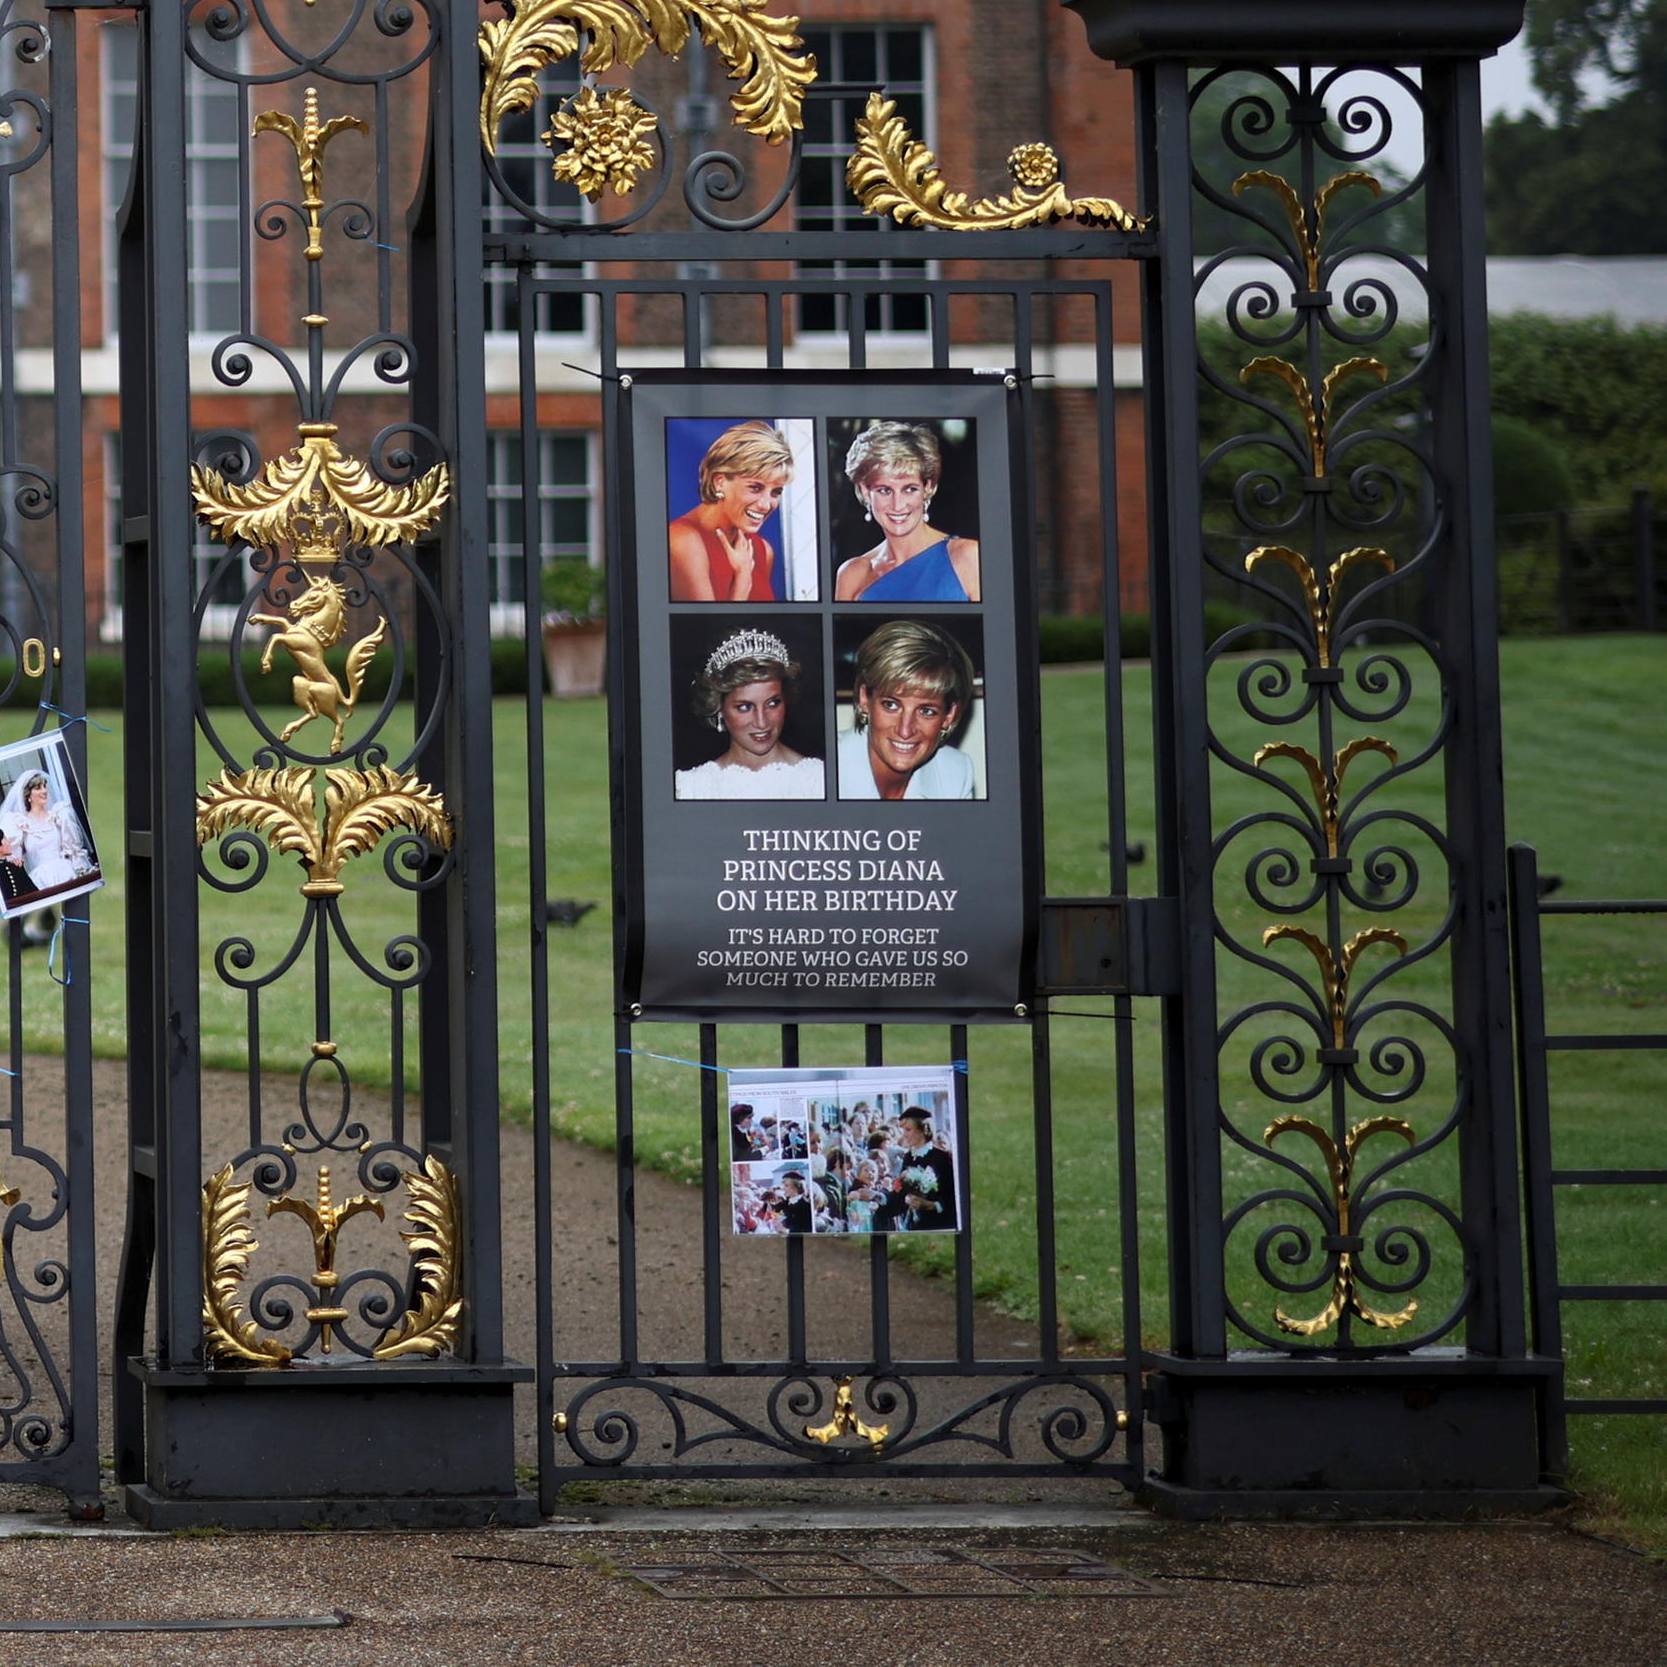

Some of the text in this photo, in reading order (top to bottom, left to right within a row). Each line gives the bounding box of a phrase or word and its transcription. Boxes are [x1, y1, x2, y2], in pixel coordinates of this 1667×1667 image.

[743, 829, 922, 851] THINKING OF
[723, 859, 945, 882] PRINCESS DIANA
[717, 889, 958, 912] ON HER BIRTHDAY
[728, 927, 940, 945] IT'S HARD TO FORGET
[697, 950, 969, 967] SOMEONE WHO GAVE US SO
[726, 971, 936, 988] MUCH TO REMEMBER
